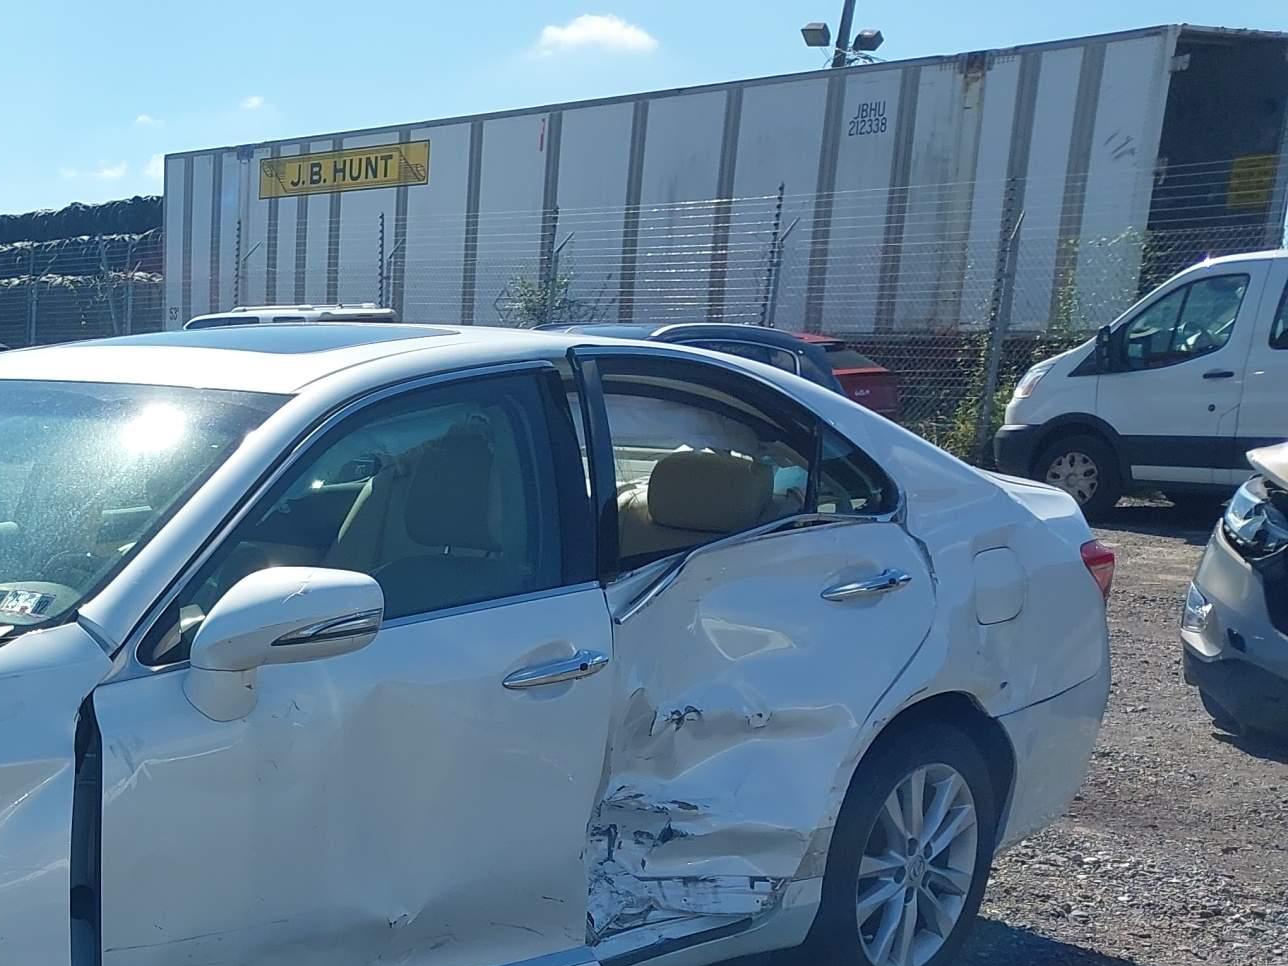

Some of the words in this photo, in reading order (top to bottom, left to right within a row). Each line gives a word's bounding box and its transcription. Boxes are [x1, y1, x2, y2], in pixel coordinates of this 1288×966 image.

[852, 100, 887, 120] JBHU
[848, 116, 888, 137] 212338
[332, 154, 394, 183] HUNT
